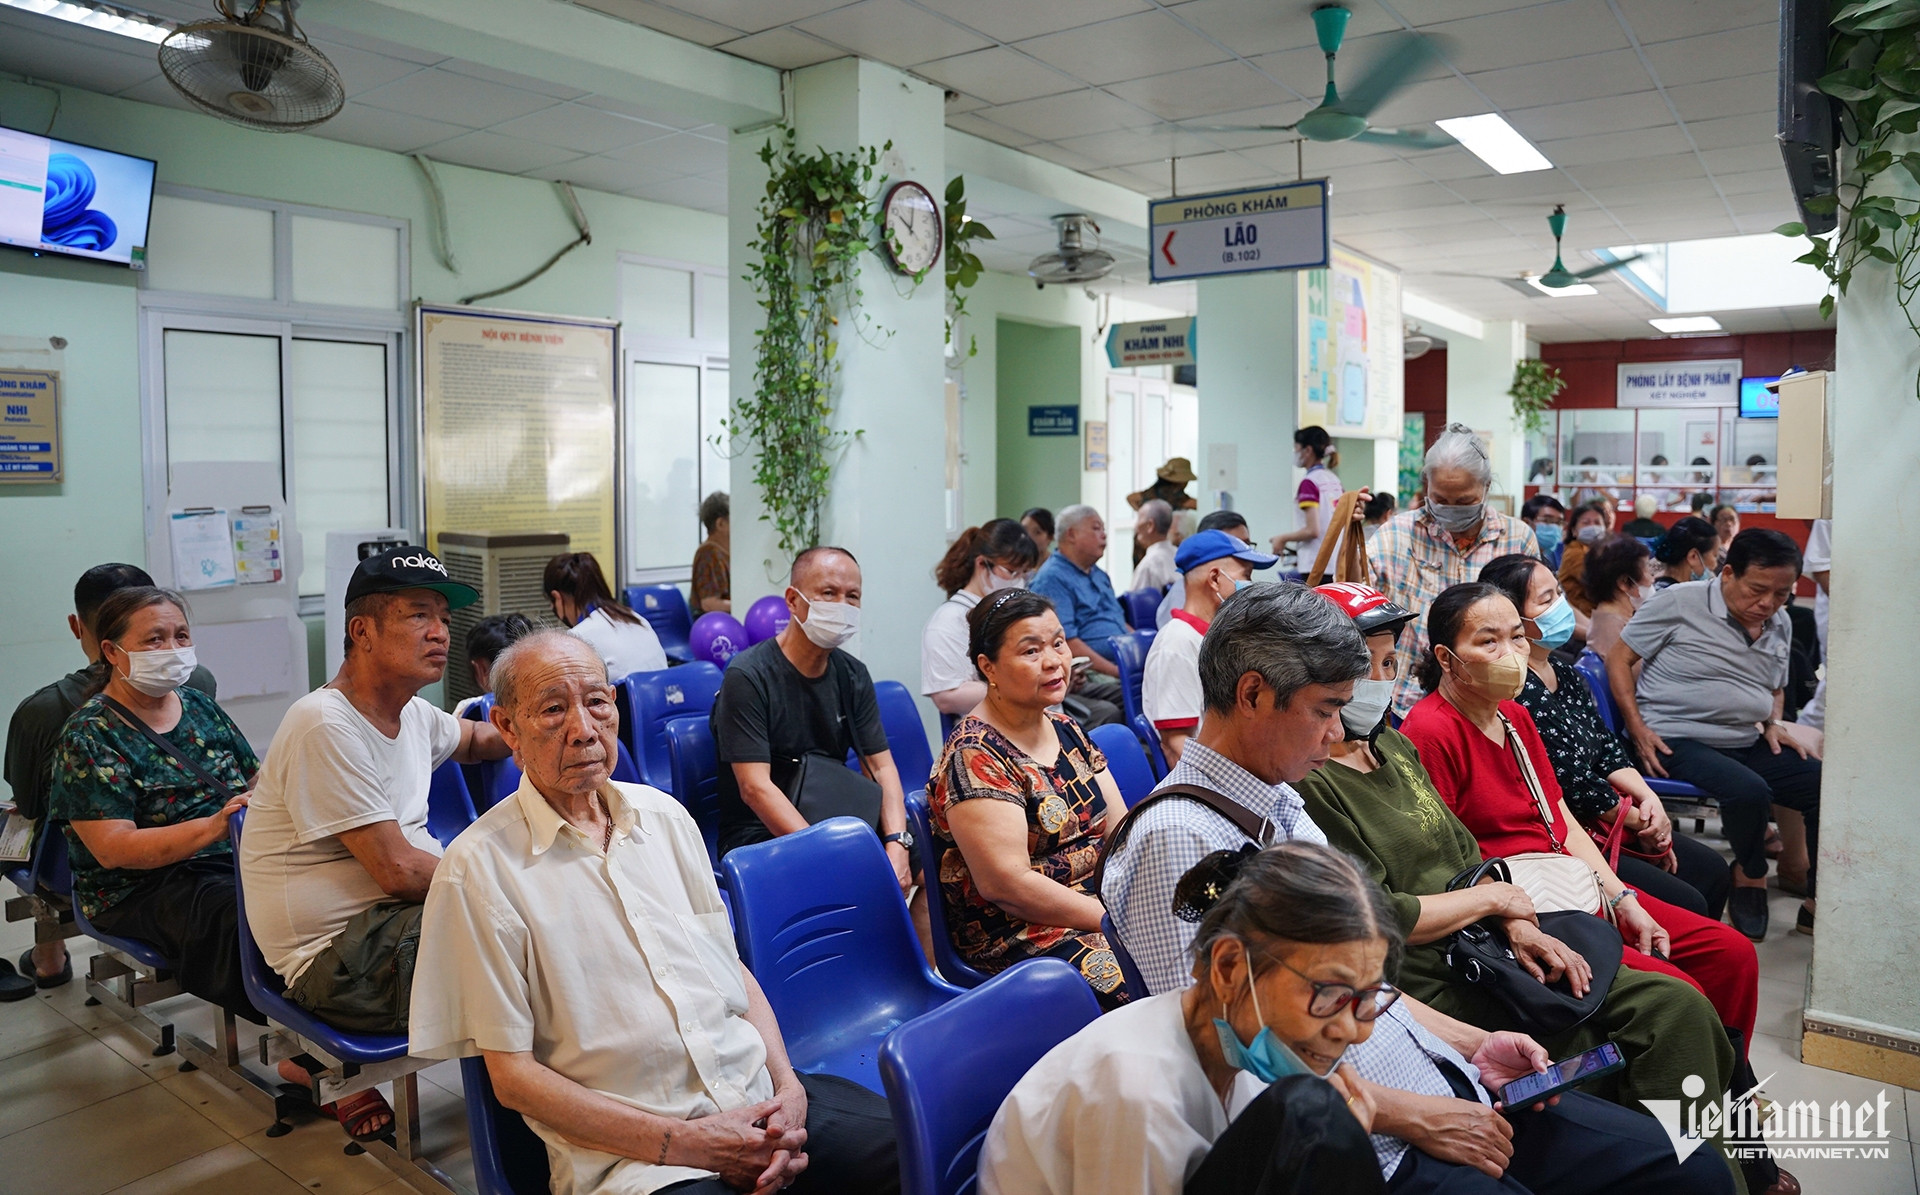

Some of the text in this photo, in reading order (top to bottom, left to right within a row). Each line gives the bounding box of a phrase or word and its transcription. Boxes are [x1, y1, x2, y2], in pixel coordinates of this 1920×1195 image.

[1183, 196, 1288, 220] PHÒNG KHÁM
[1224, 222, 1258, 247] LÃO
[1222, 249, 1261, 264] (B.102)
[499, 332, 517, 341] QUY
[519, 332, 542, 343] BỆNH
[544, 334, 564, 345] VIỆN
[1124, 335, 1185, 352] KHÁM NHI
[1626, 366, 1731, 388] PHÒNG LẤY BỆNH PHẨM
[20, 380, 47, 390] KHÁM
[1670, 389, 1707, 400] NGHIỆM
[7, 405, 27, 415] NHI
